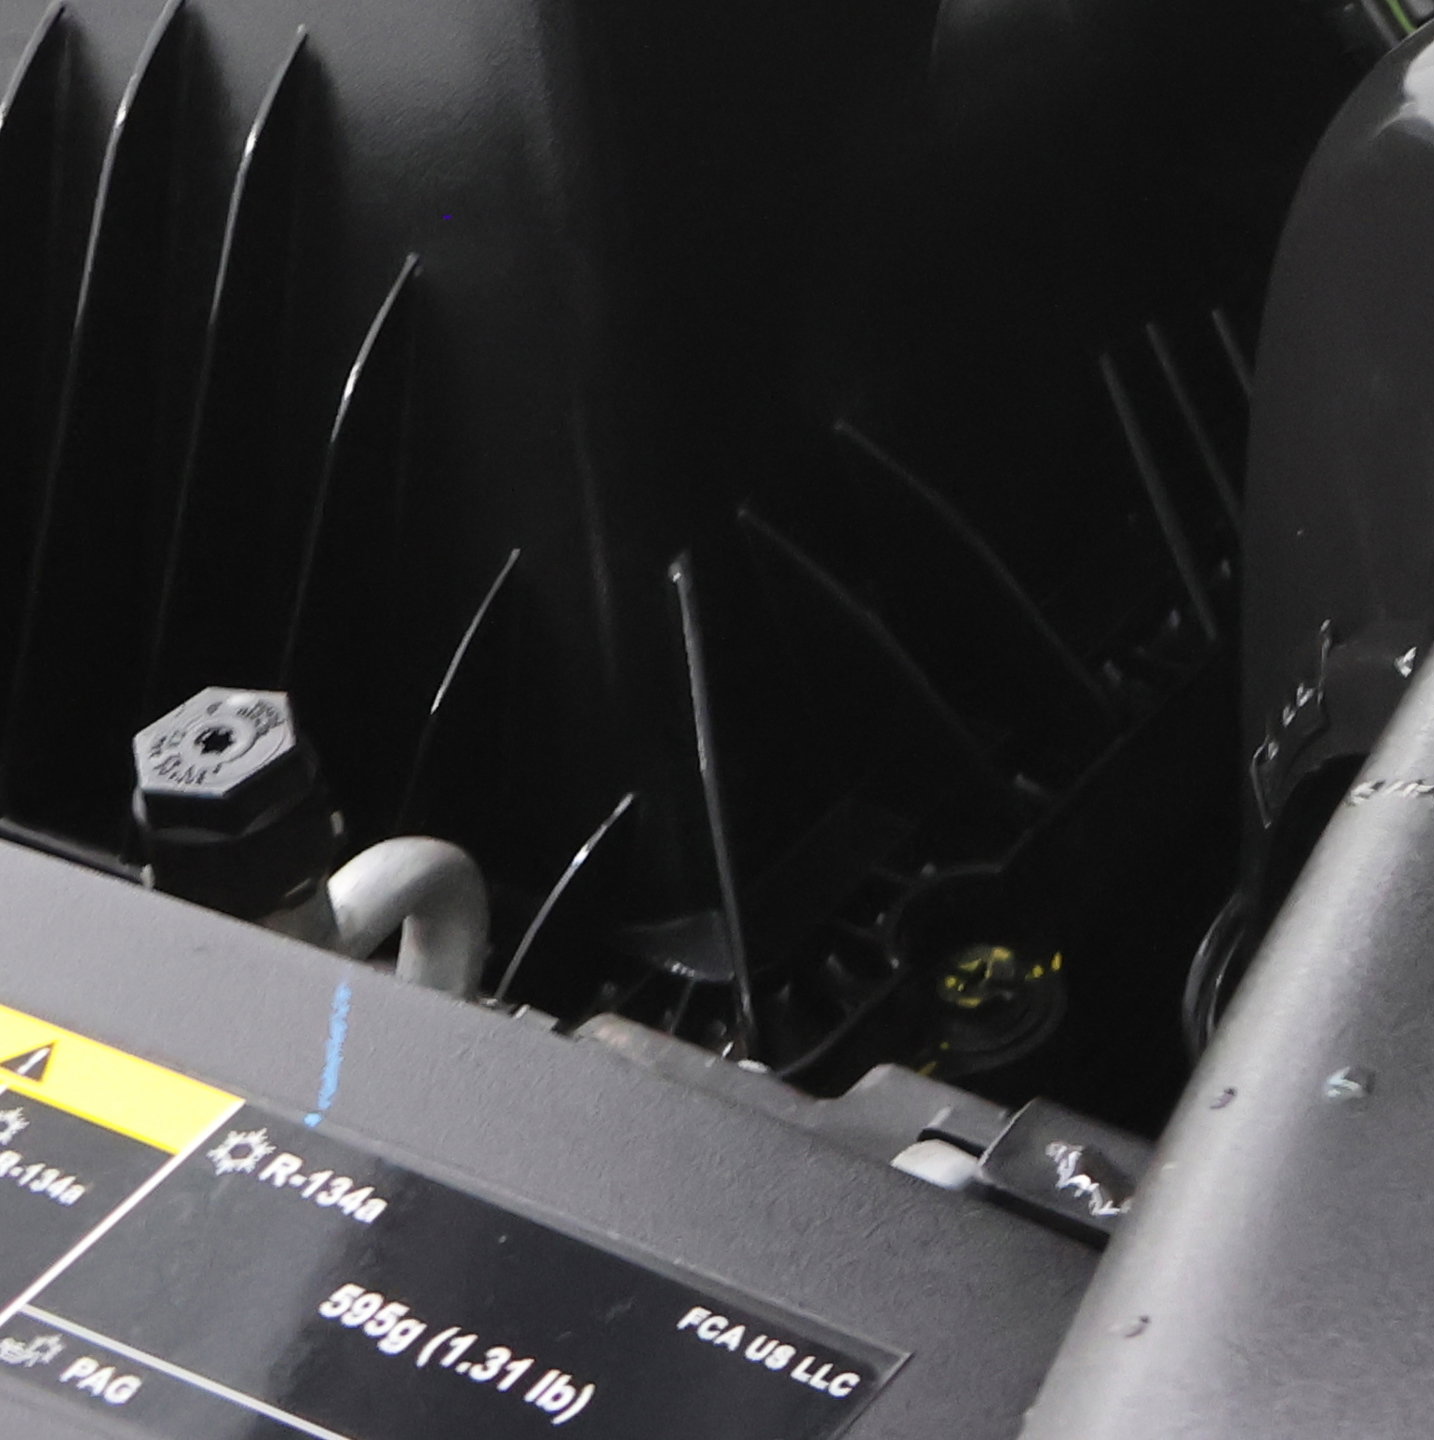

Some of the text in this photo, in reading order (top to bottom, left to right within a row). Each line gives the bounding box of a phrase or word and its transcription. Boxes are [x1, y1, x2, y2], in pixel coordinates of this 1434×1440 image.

[258, 1152, 388, 1224] R-134a
[59, 1355, 143, 1405] PAG
[318, 1283, 596, 1425] 595g (1.31 lb)
[676, 1306, 862, 1398] FCA US LLC
